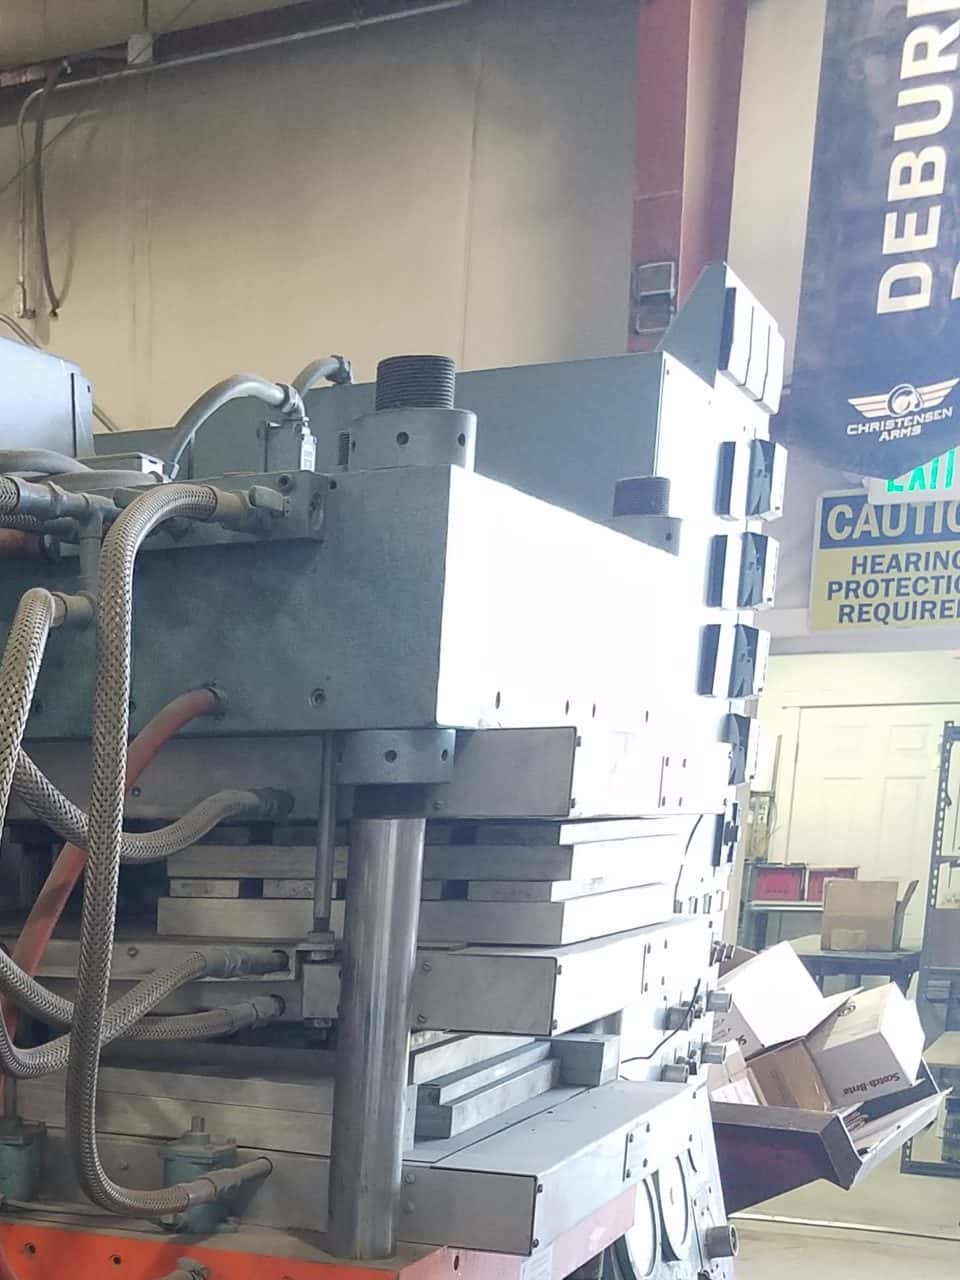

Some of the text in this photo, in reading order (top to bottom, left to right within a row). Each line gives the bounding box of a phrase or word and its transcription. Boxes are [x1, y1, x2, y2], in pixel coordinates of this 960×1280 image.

[846, 407, 953, 435] CHRISTENSEN
[878, 425, 922, 442] ARMS
[838, 599, 960, 625] REQUIRE
